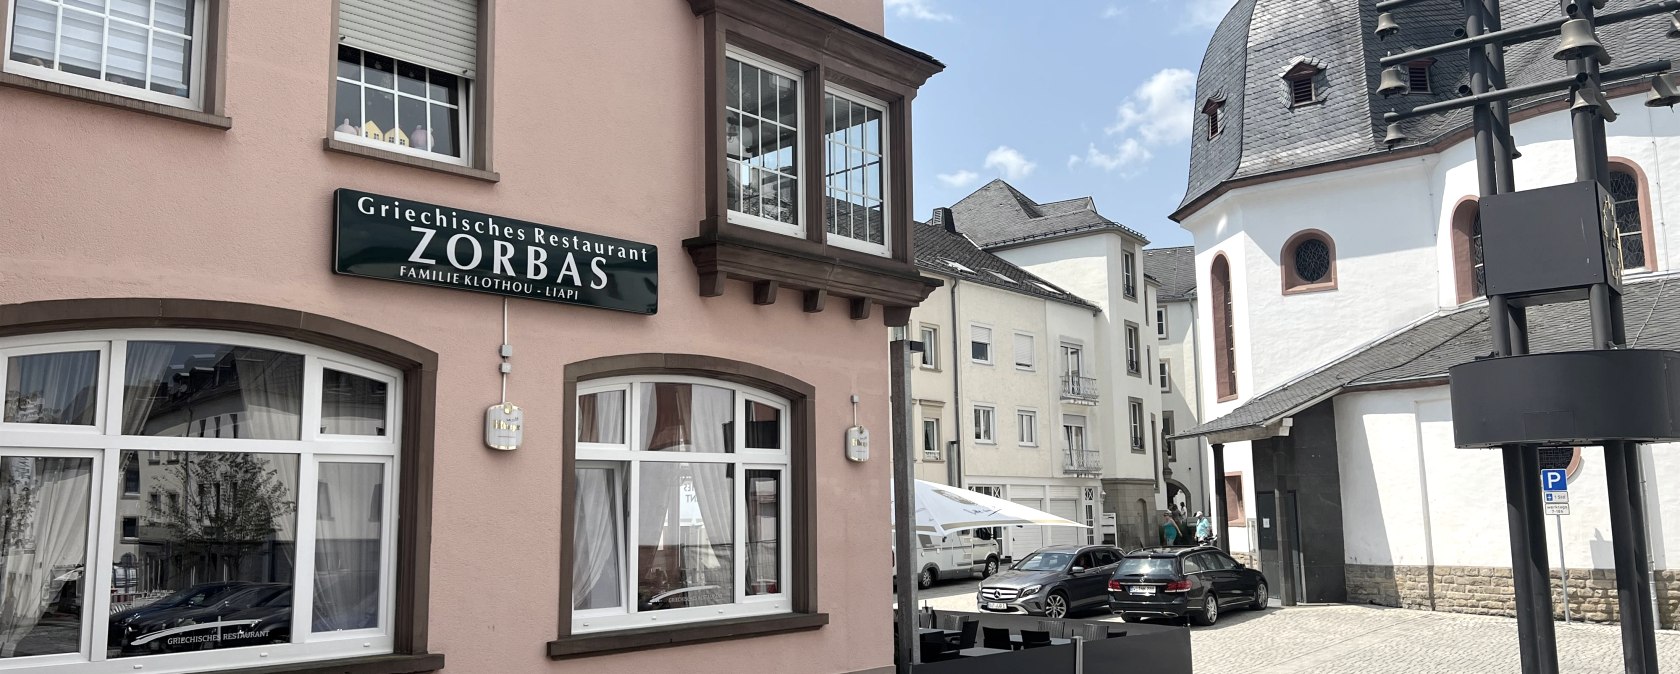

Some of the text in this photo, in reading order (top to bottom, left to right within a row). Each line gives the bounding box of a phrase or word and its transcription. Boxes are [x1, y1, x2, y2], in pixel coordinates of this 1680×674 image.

[357, 196, 647, 262] Griechisches Restaurant
[408, 226, 608, 290] ZORBAS
[400, 265, 459, 283] FAMILIE
[464, 274, 533, 294] KLOTHOU
[545, 286, 579, 300] LIAPI
[1547, 472, 1561, 488] P
[167, 630, 270, 645] GRIECHISCHES RESTAURANT
